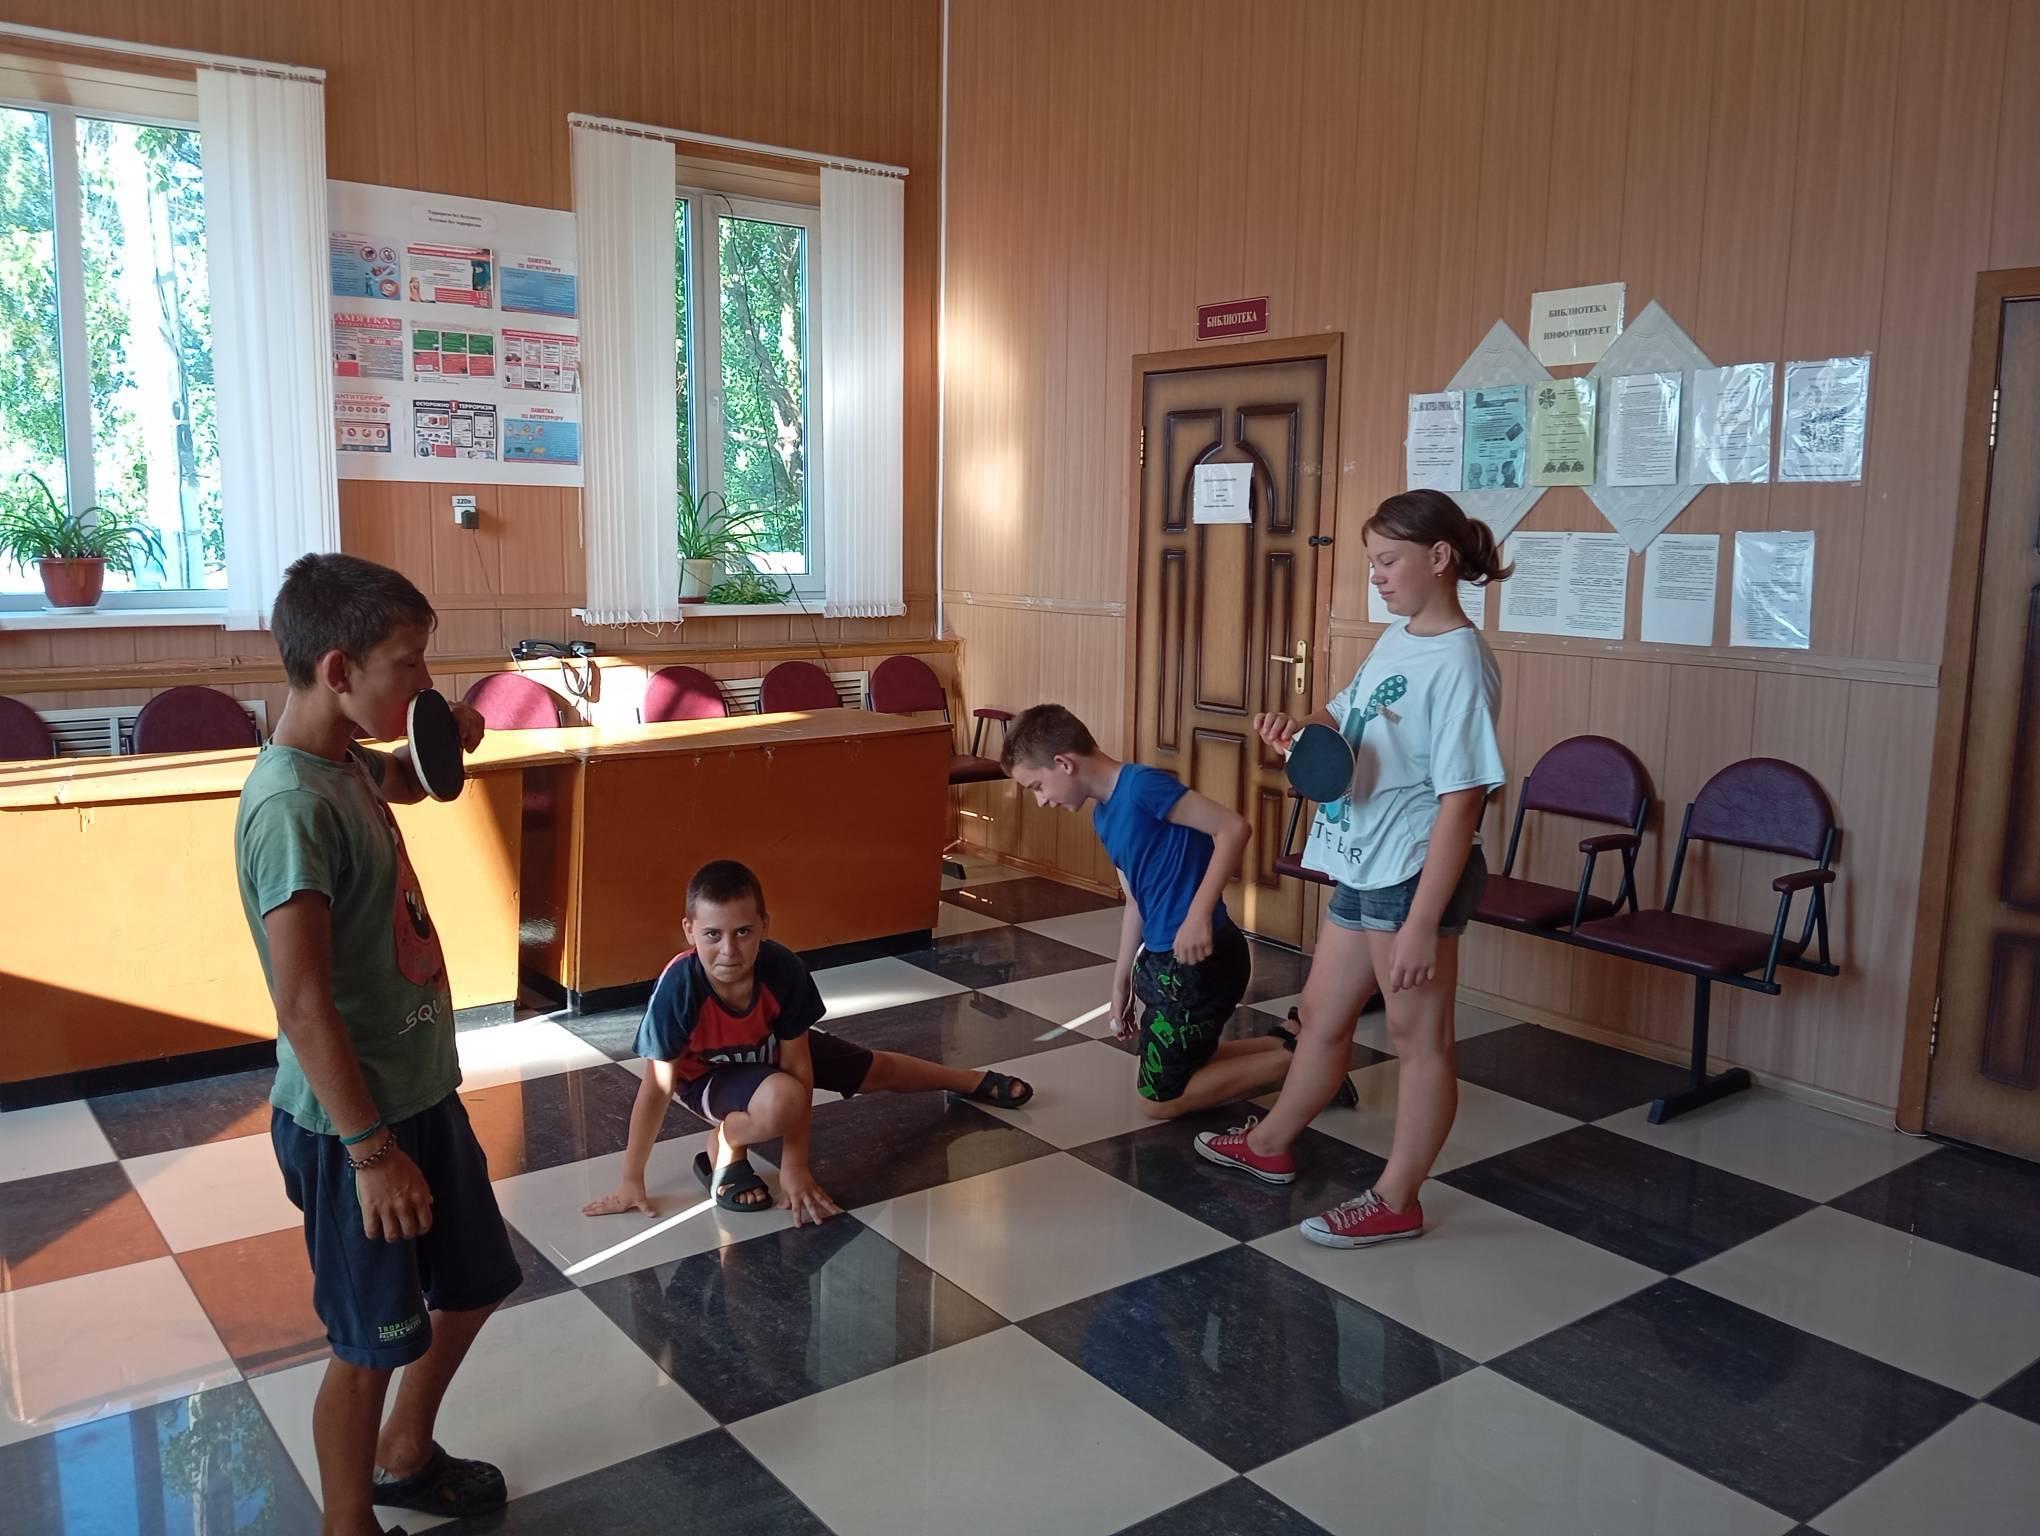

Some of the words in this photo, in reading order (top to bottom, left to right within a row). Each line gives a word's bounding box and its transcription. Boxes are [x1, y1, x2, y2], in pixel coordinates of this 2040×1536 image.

[1548, 304, 1608, 318] БИБЛИОТЕКА
[1207, 311, 1257, 328] БИБЛИОТЕКА
[1543, 325, 1611, 340] ИНФОРМИРУЕТ
